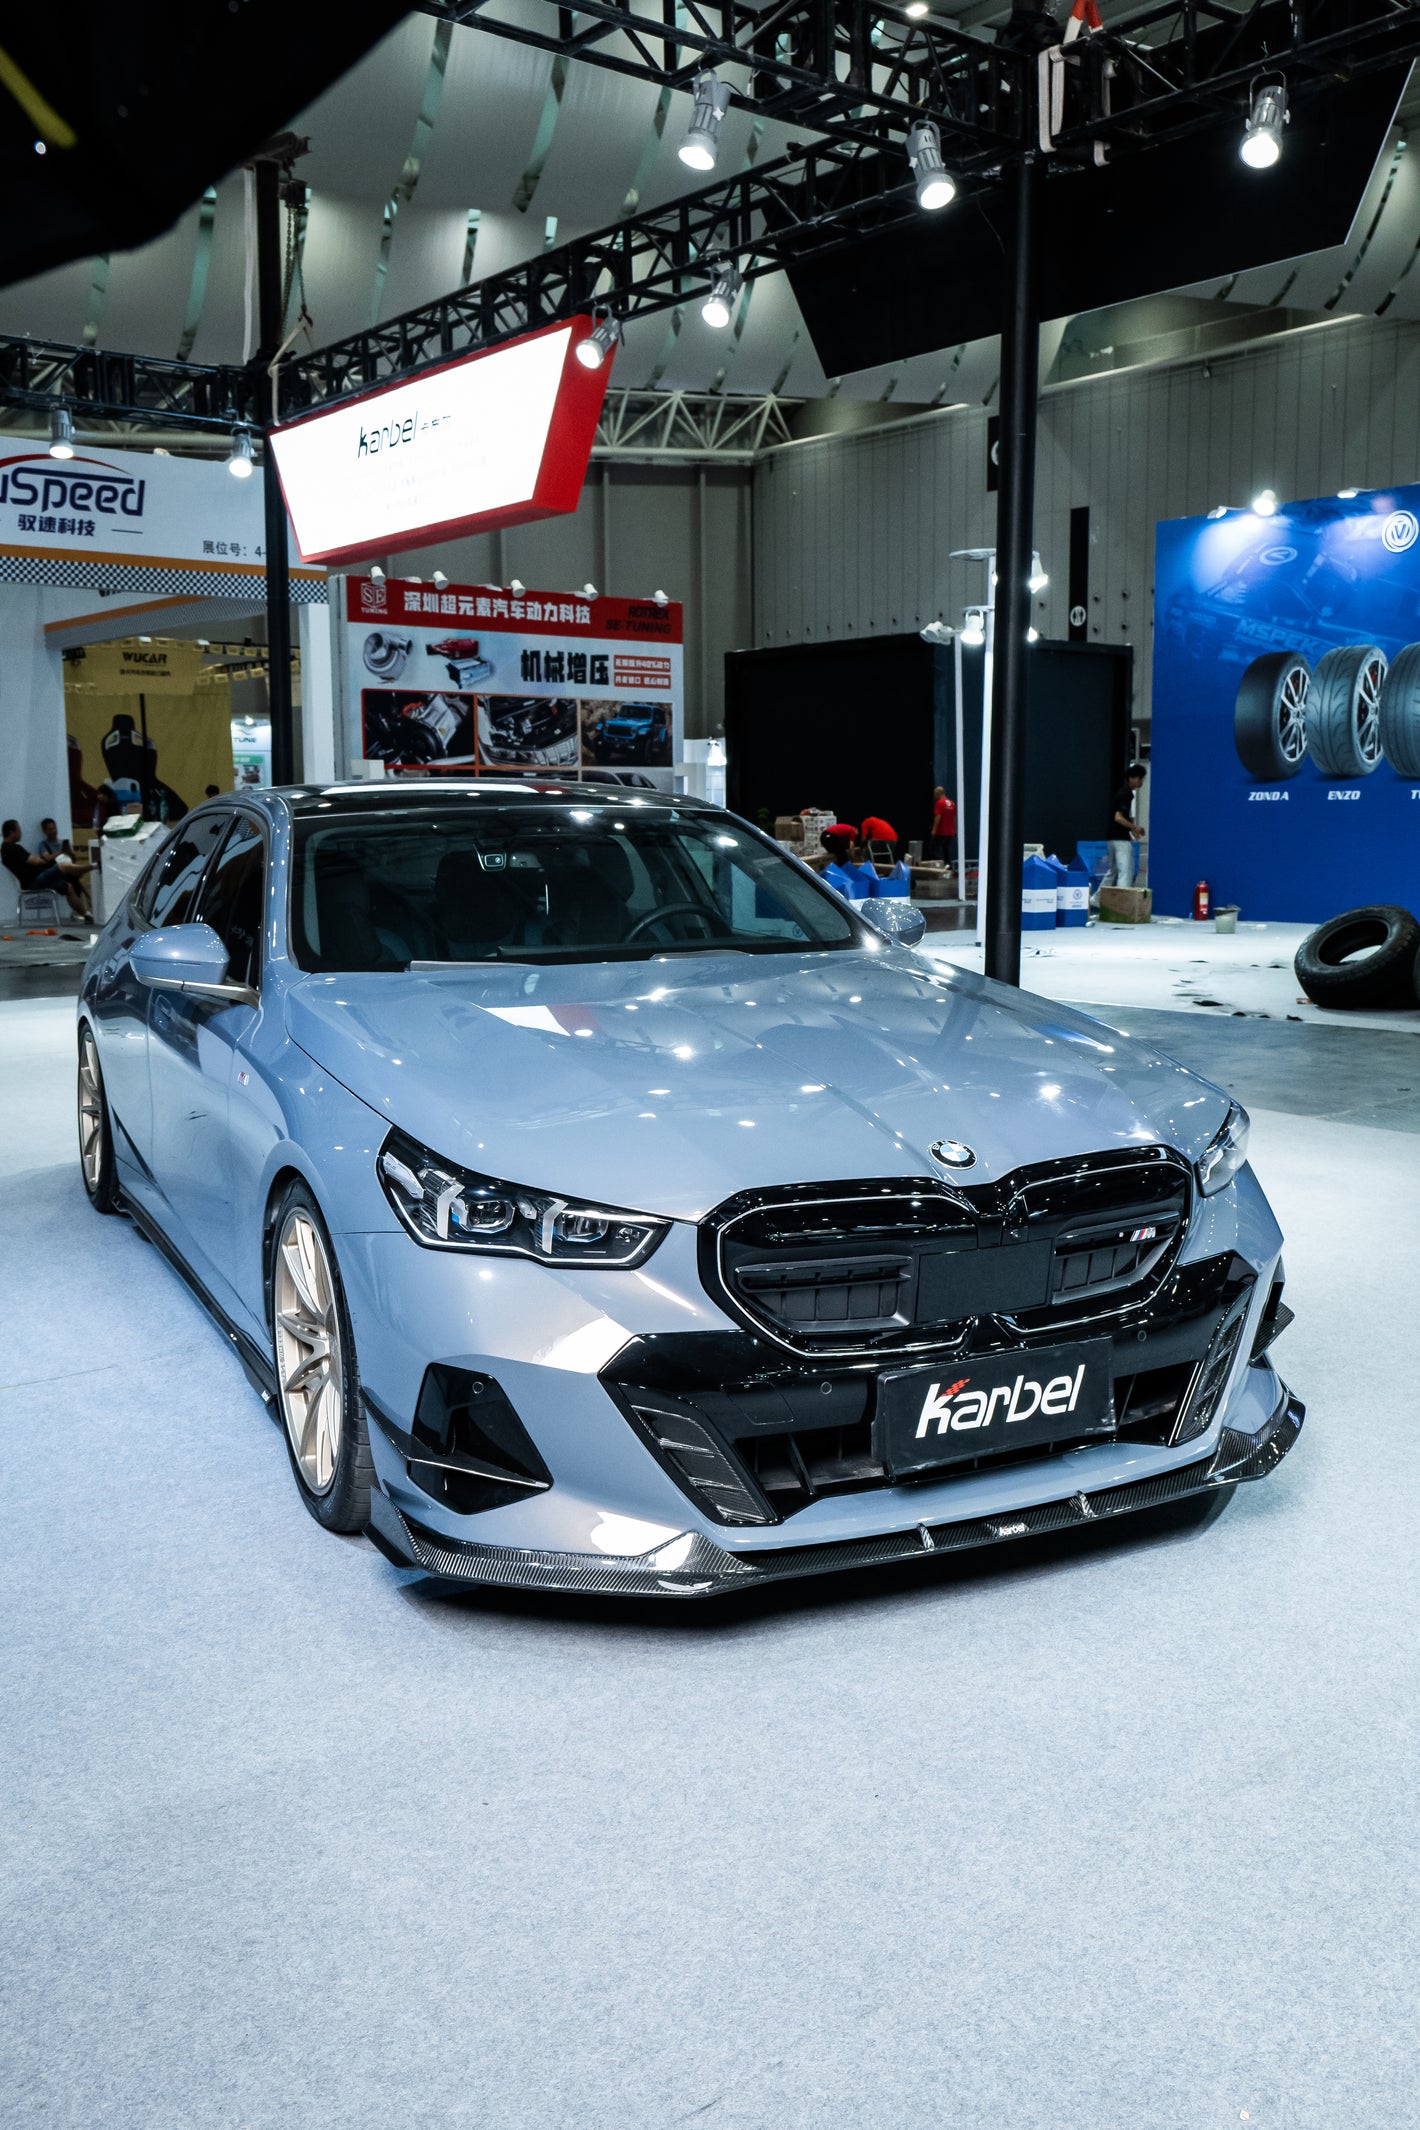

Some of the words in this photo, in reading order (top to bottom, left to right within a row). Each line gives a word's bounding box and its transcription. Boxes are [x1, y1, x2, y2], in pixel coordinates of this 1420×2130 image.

[17, 513, 96, 537] 驭速科技
[403, 591, 591, 625] 深圳超元素汽车动力科技
[122, 651, 168, 664] WUCAR
[521, 649, 609, 686] 机械增压
[1248, 791, 1290, 801] ZONDA
[1327, 790, 1361, 800] ENZO
